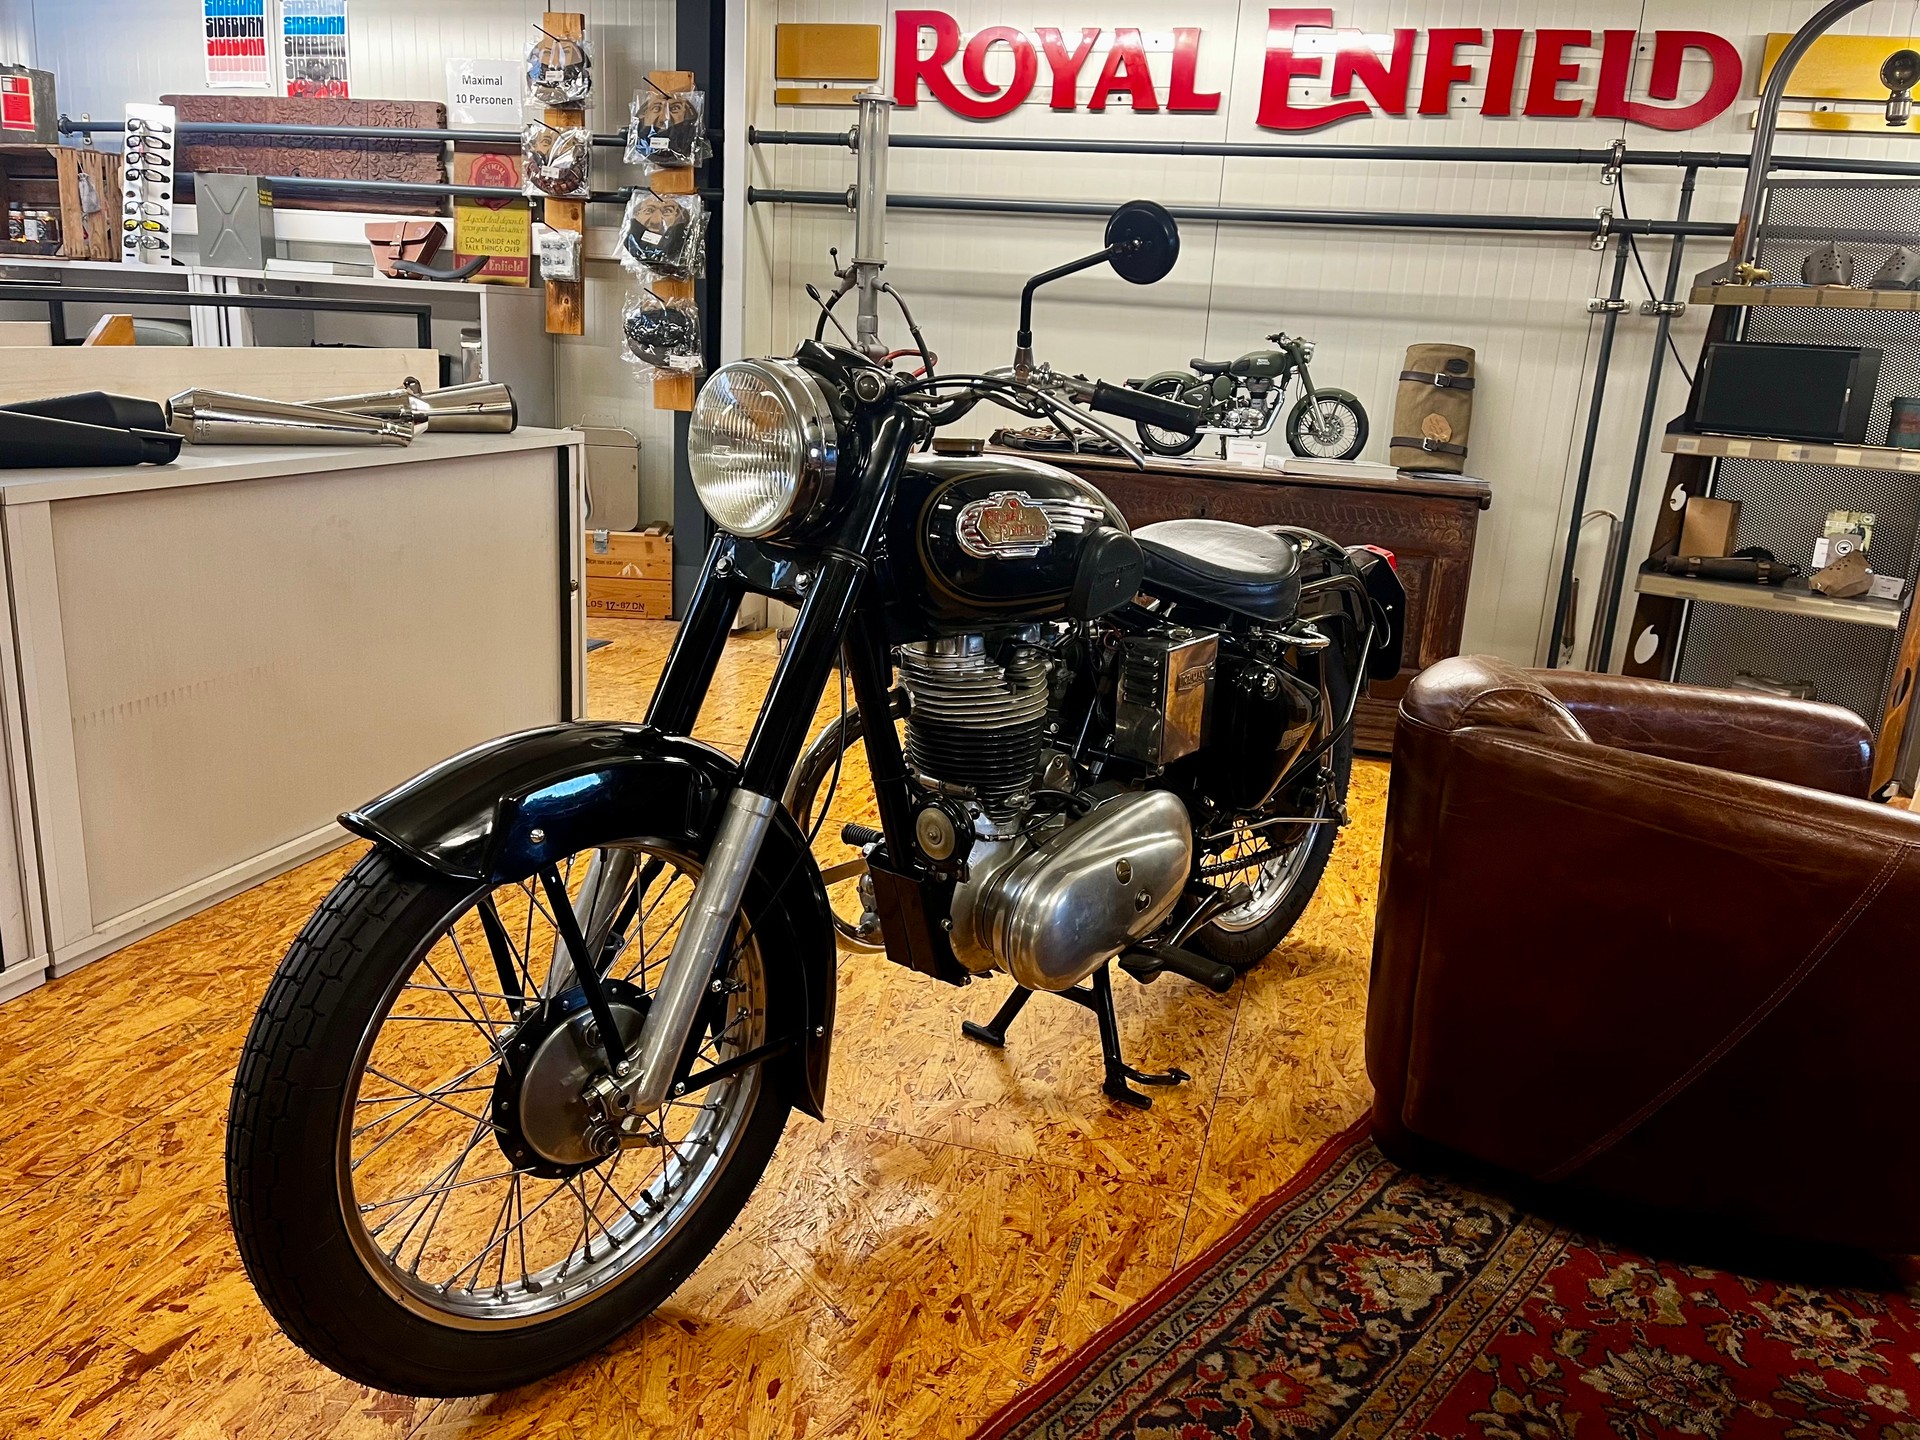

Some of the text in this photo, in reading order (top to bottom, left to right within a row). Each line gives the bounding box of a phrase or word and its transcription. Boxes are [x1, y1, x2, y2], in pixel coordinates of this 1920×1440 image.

[205, 0, 264, 16] SIDEBURN
[284, 0, 345, 15] SIDEBURN
[206, 17, 265, 37] SIDEBURN
[284, 16, 345, 35] SIDEBURN
[285, 36, 346, 57] SIDEBURN
[894, 8, 1744, 131] ROYAL ENFIELD
[462, 75, 503, 86] Maximal
[456, 94, 513, 105] 10 Personen
[481, 163, 506, 177] OFFICIAL
[481, 244, 503, 252] THINGS
[489, 259, 524, 272] Enfield
[632, 602, 645, 610] DN
